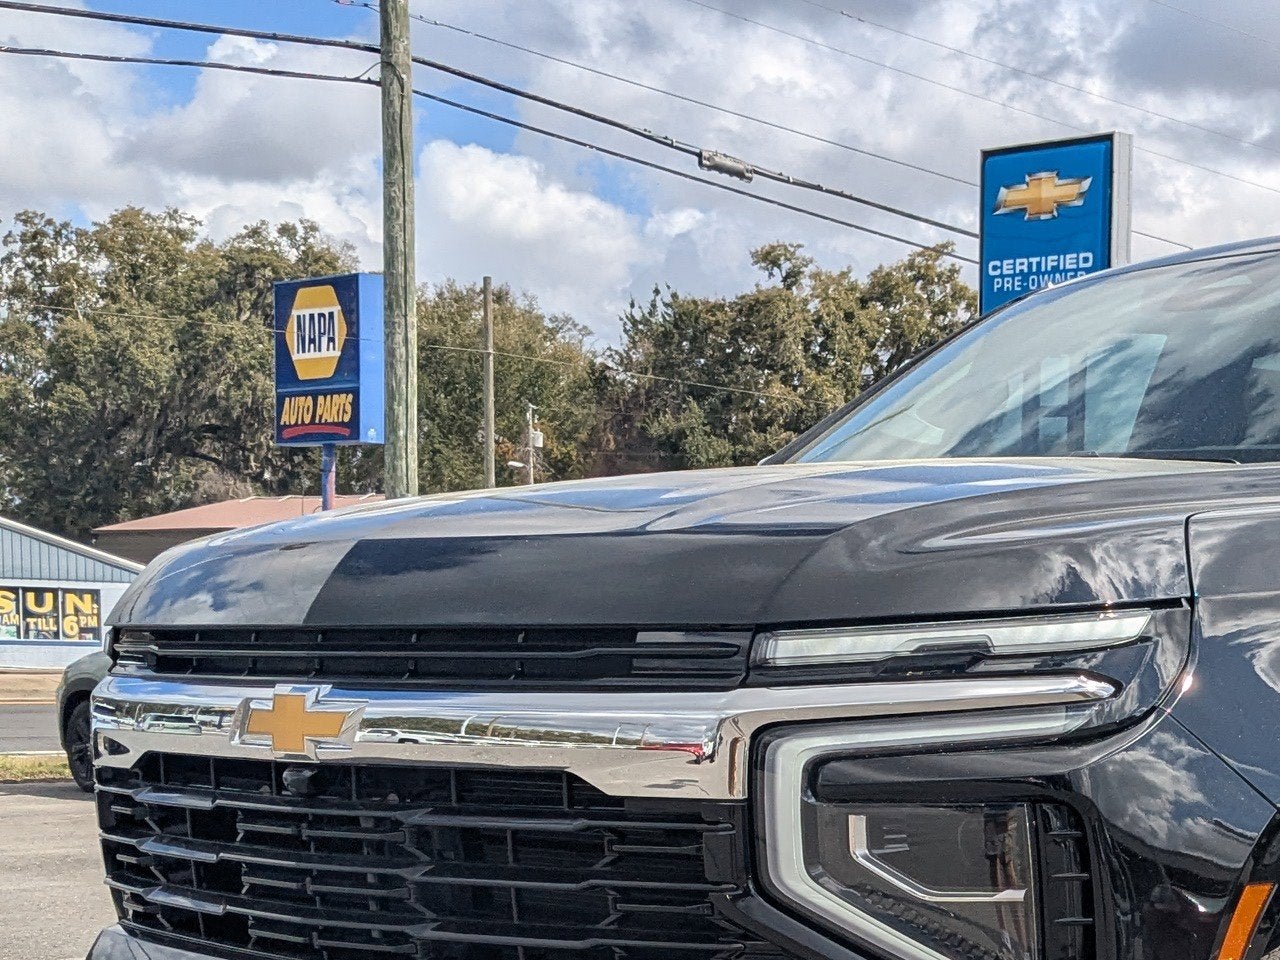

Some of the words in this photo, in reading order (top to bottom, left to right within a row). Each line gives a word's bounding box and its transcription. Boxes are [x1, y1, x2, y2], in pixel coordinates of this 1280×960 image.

[988, 252, 1093, 276] CERTIFIED
[296, 311, 336, 354] NAPA
[280, 396, 313, 425] AUTO
[315, 393, 353, 424] PARTS
[26, 617, 58, 631] TILL
